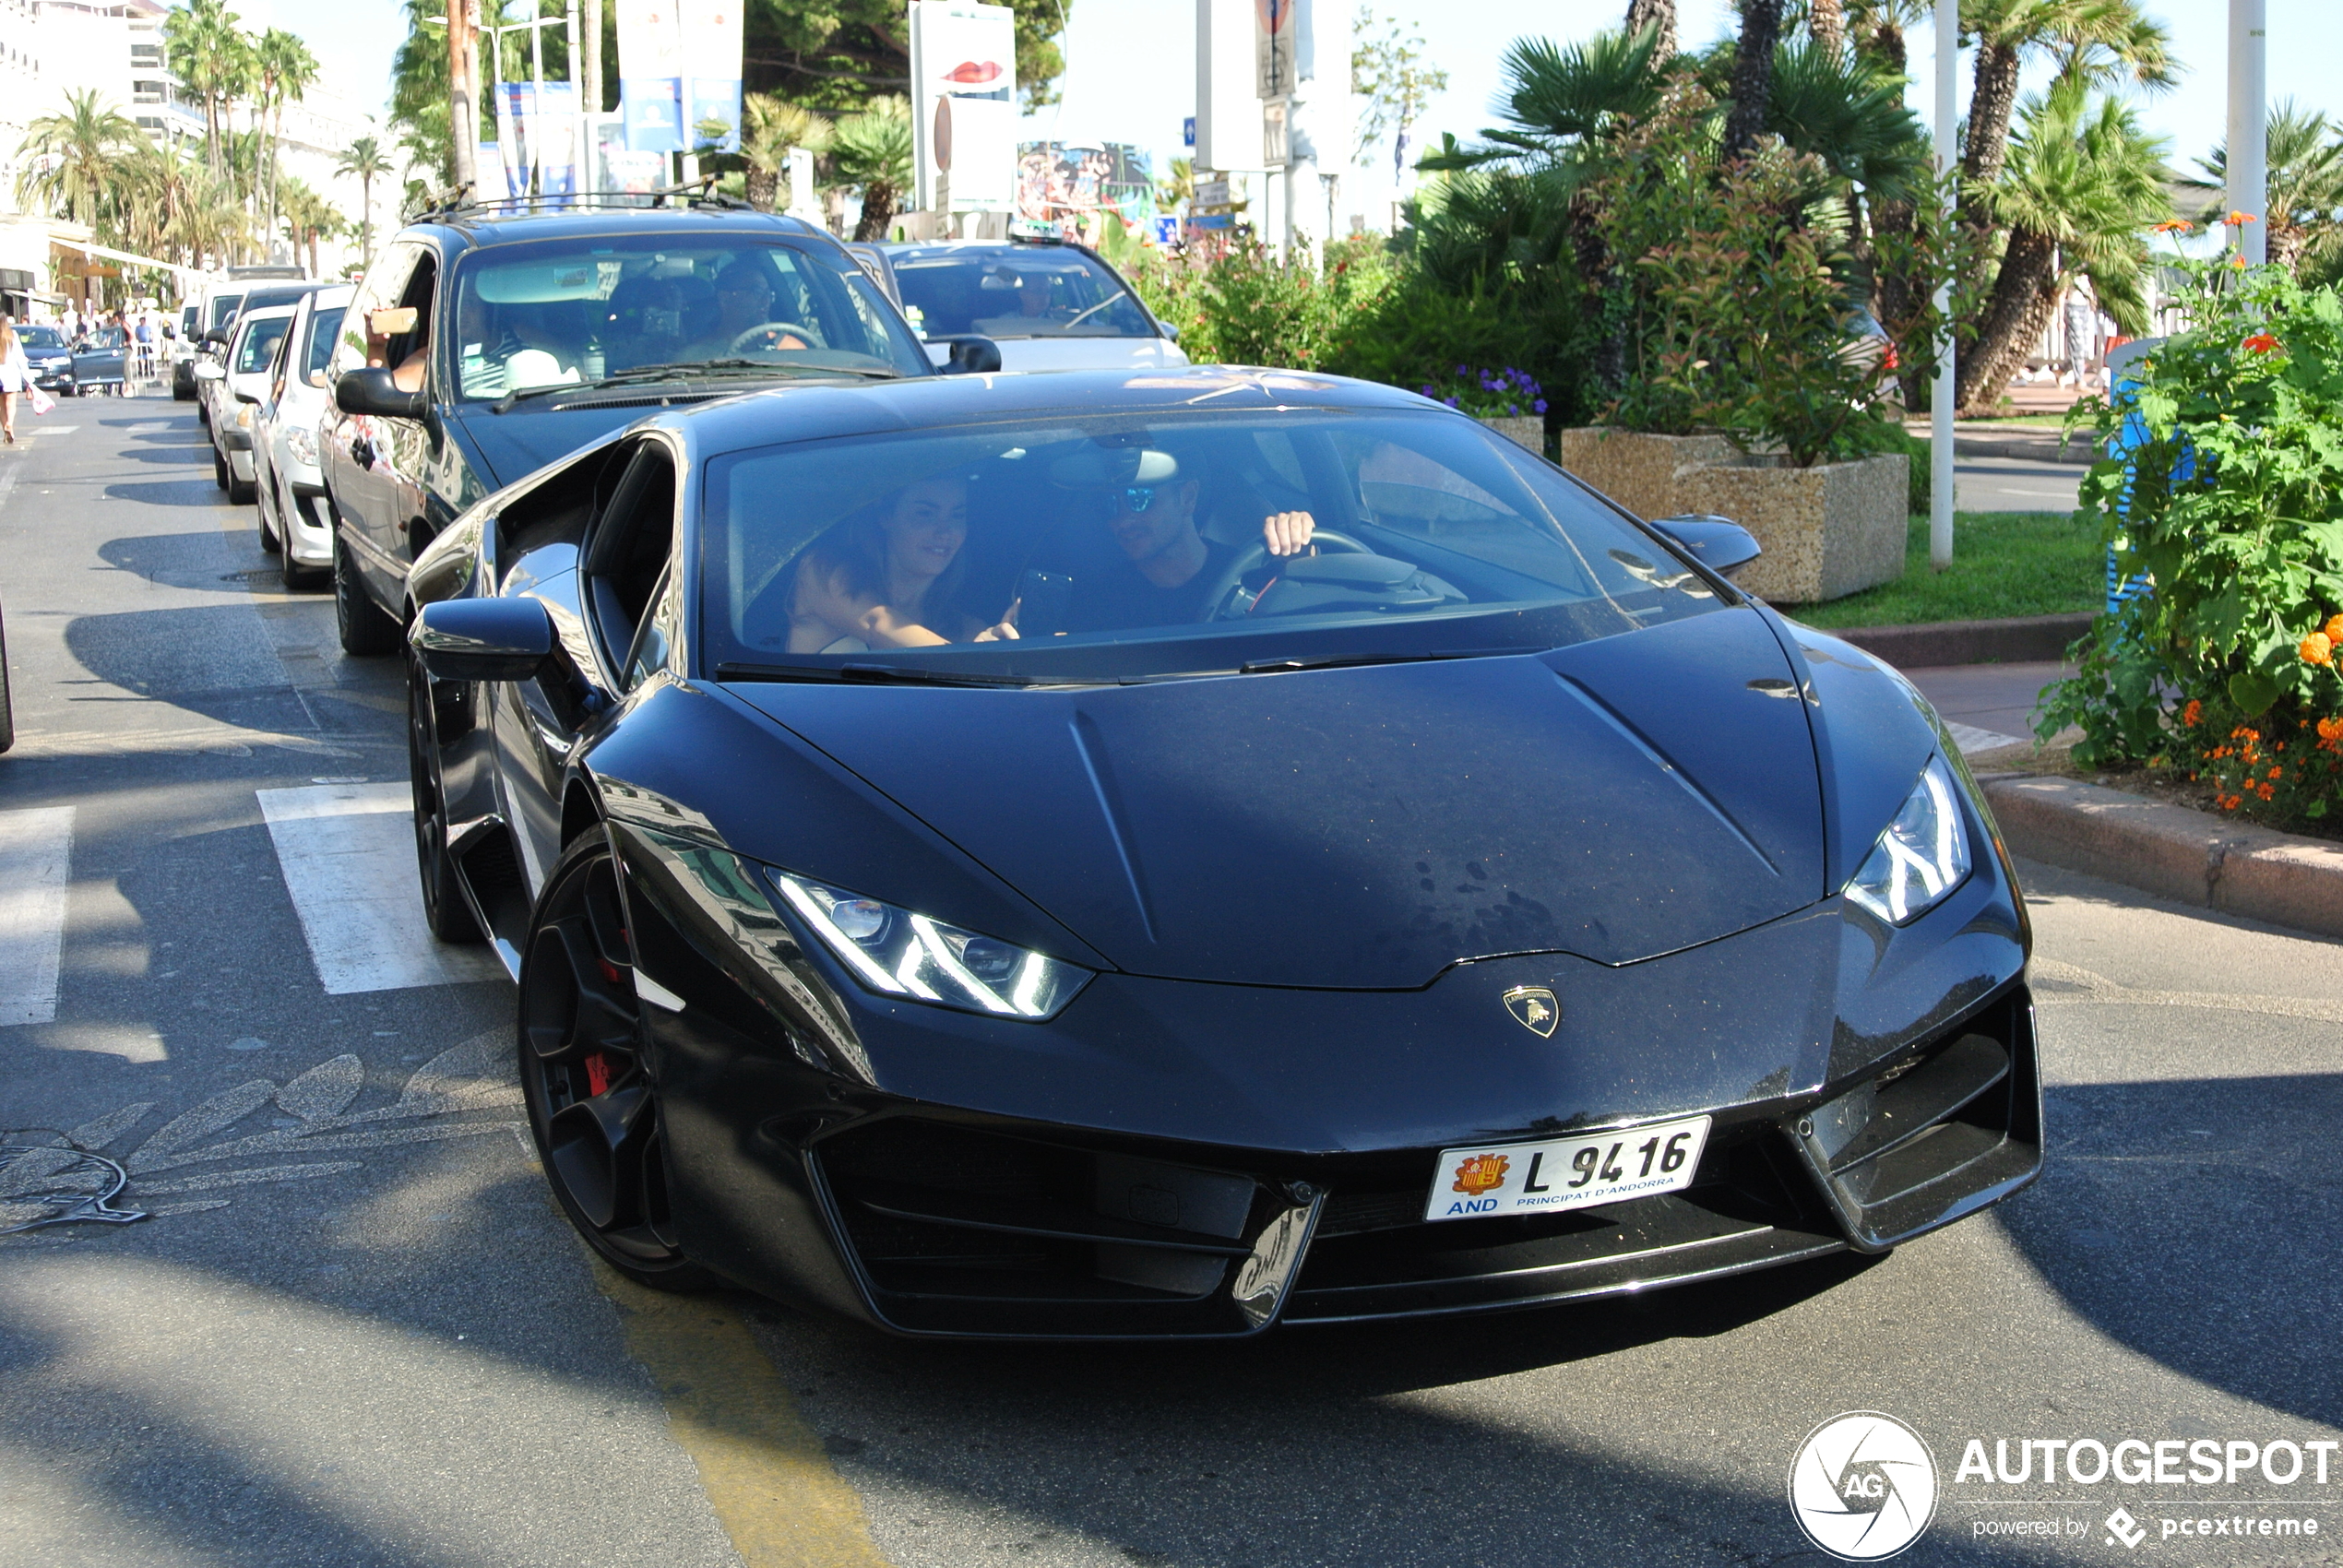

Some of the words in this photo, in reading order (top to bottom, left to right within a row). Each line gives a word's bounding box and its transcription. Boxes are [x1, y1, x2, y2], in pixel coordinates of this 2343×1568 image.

[1506, 991, 1552, 1004] LAMBORGHINI
[1516, 1191, 1590, 1206] PRINCIPAT
[1595, 1177, 1674, 1196] D'ANDORRA
[1446, 1198, 1498, 1216] AND
